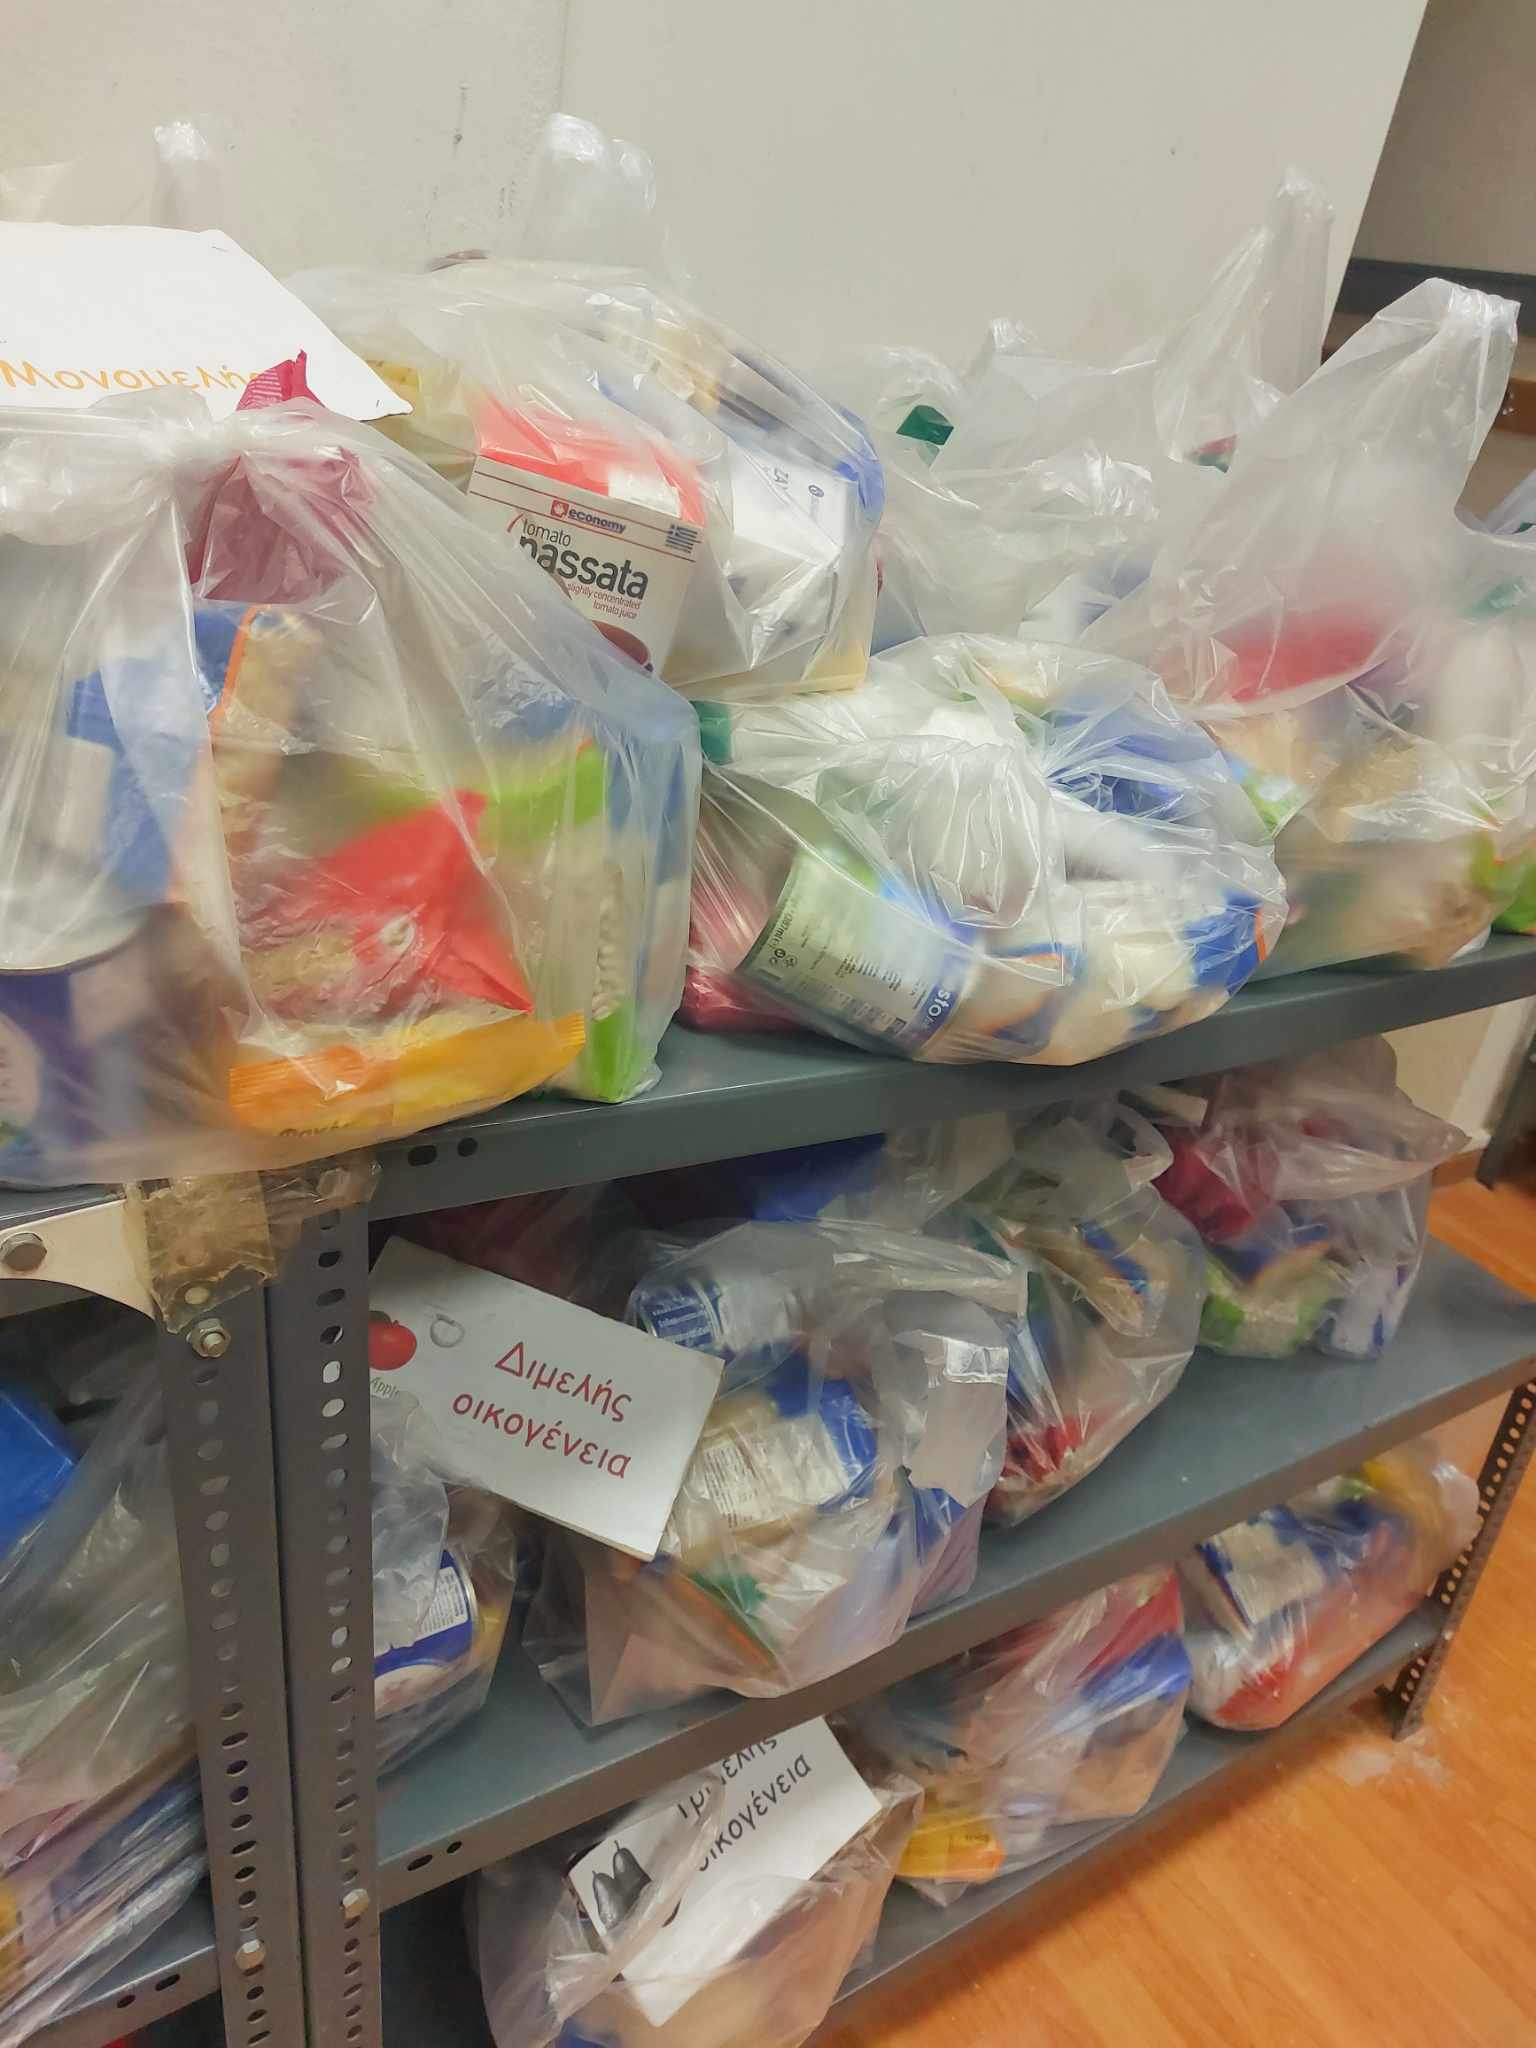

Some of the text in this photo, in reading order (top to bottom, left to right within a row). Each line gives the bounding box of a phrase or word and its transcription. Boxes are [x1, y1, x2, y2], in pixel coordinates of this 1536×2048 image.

[523, 518, 571, 547] tomato
[568, 507, 626, 534] economy
[494, 1341, 632, 1422] Διμελής
[452, 1393, 631, 1479] οικογένεια
